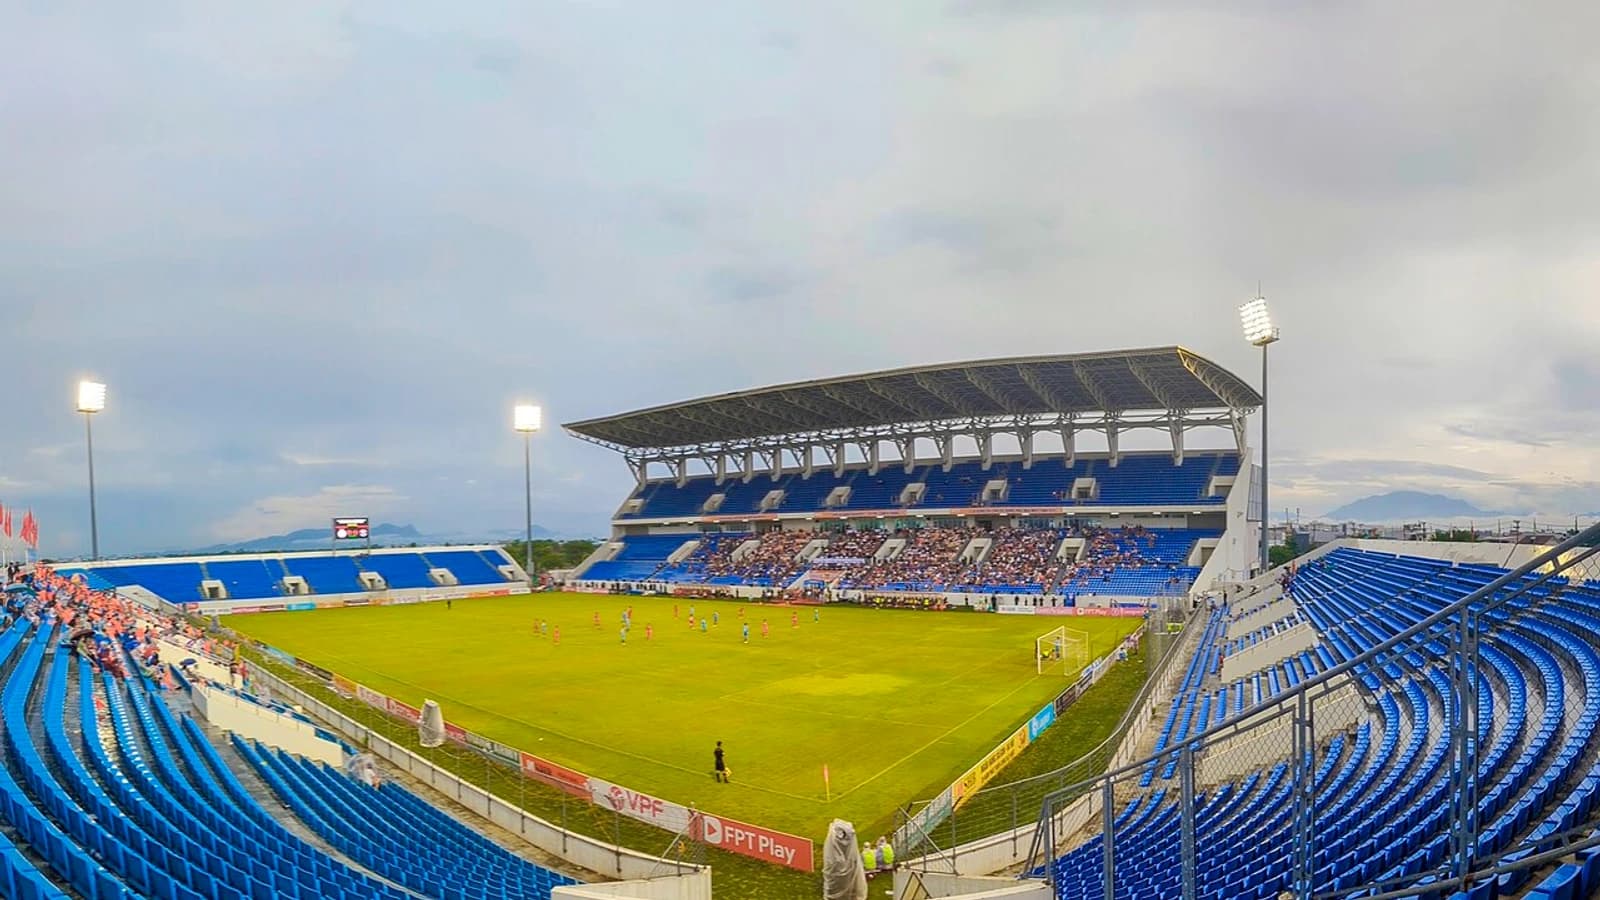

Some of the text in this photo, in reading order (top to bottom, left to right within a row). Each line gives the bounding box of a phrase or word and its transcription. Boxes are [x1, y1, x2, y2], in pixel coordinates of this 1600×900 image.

[626, 791, 664, 817] VPF
[724, 827, 796, 865] FPT Play
